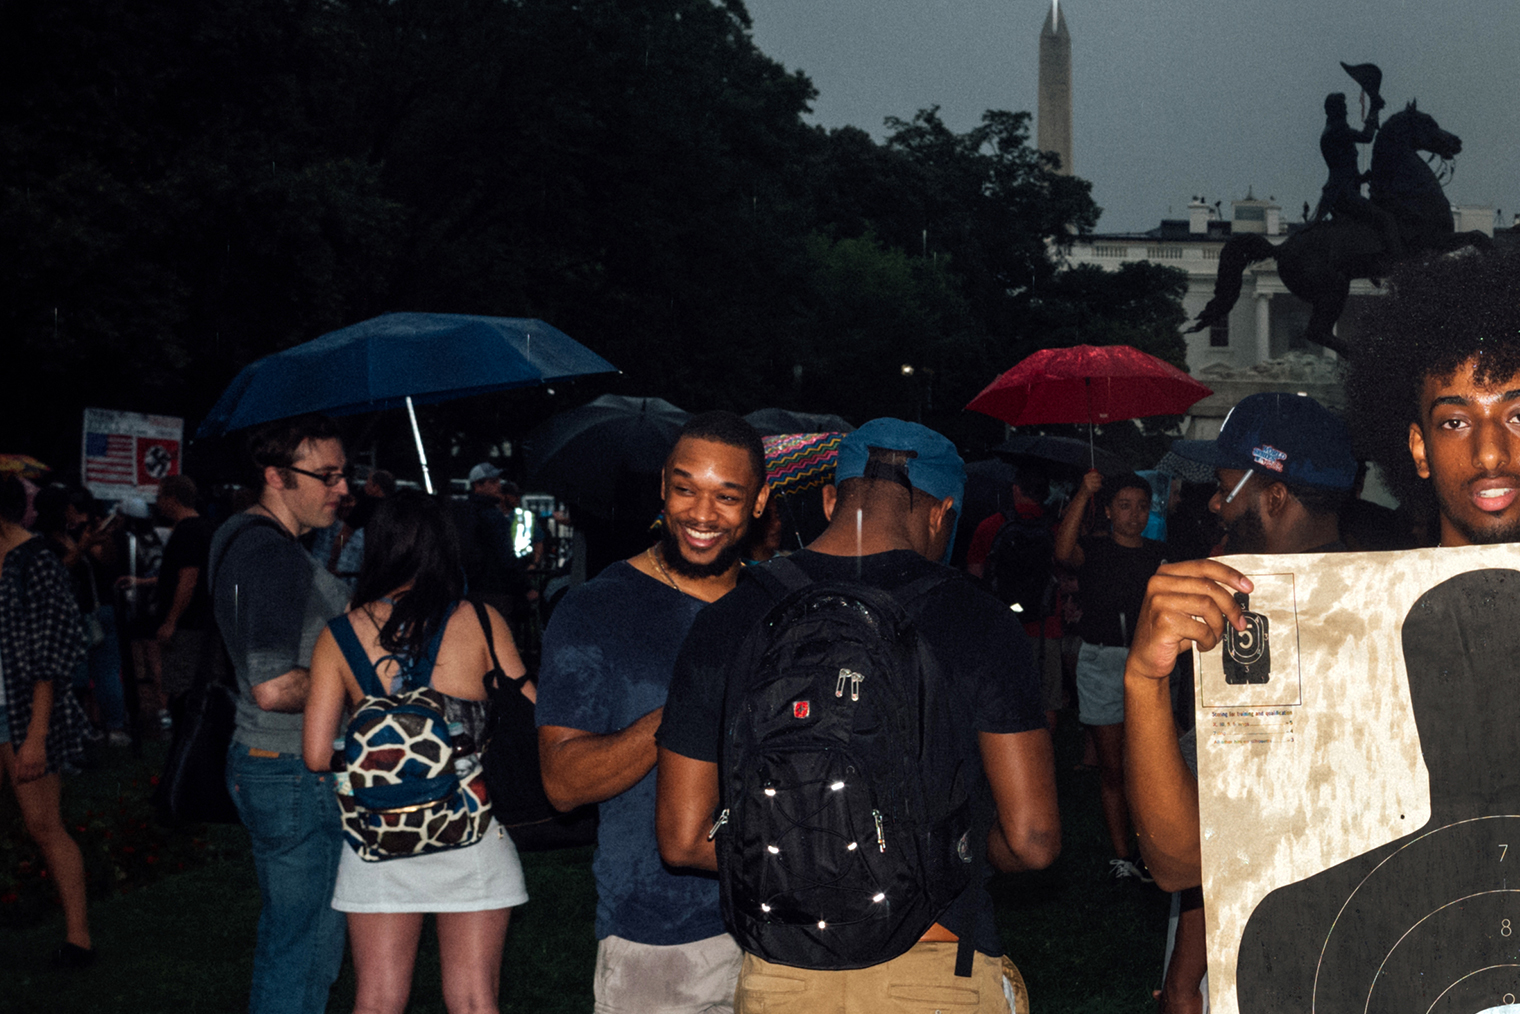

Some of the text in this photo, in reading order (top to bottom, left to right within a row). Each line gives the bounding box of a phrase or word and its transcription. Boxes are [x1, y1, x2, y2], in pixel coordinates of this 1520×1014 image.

[1265, 709, 1292, 717] qualification
[1498, 843, 1509, 863] 7
[1500, 918, 1512, 938] 8
